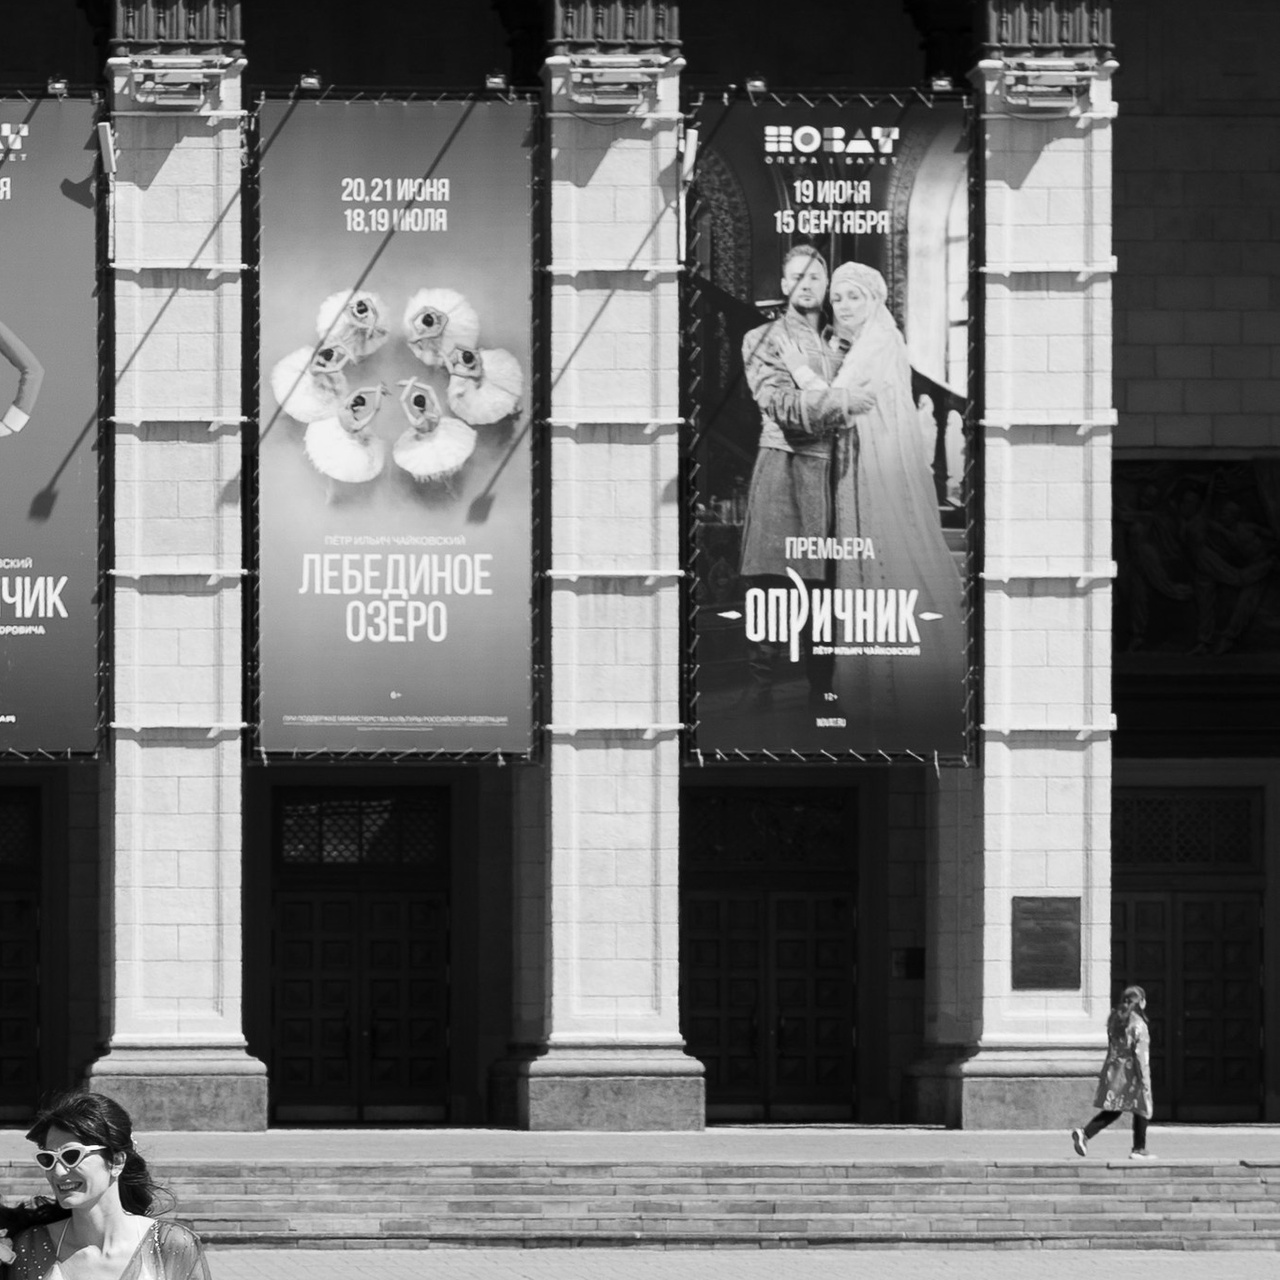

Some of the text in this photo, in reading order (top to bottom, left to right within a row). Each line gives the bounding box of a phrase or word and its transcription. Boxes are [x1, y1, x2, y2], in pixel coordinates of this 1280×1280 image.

[764, 125, 899, 153] НОВАТ
[764, 156, 818, 165] ОПЕРА
[341, 177, 450, 203] 20,21 ИЮНЯ
[793, 180, 871, 204] 19 ИЮНЯ
[344, 208, 448, 233] 18,19 ИЮЛЯ
[773, 210, 891, 234] 15 СЕНТЯБРЯ
[353, 535, 392, 546] ИЛЬИЧ
[392, 534, 467, 546] ЧАЙКОВСКИЙ
[785, 537, 875, 560] ПРЕМЬЕРА
[298, 553, 493, 599] ЛЕБЕДИНОЕ
[346, 600, 447, 643] ОЗЕРО
[745, 566, 921, 663] ОПРИЧНИК
[823, 692, 839, 702] 12+
